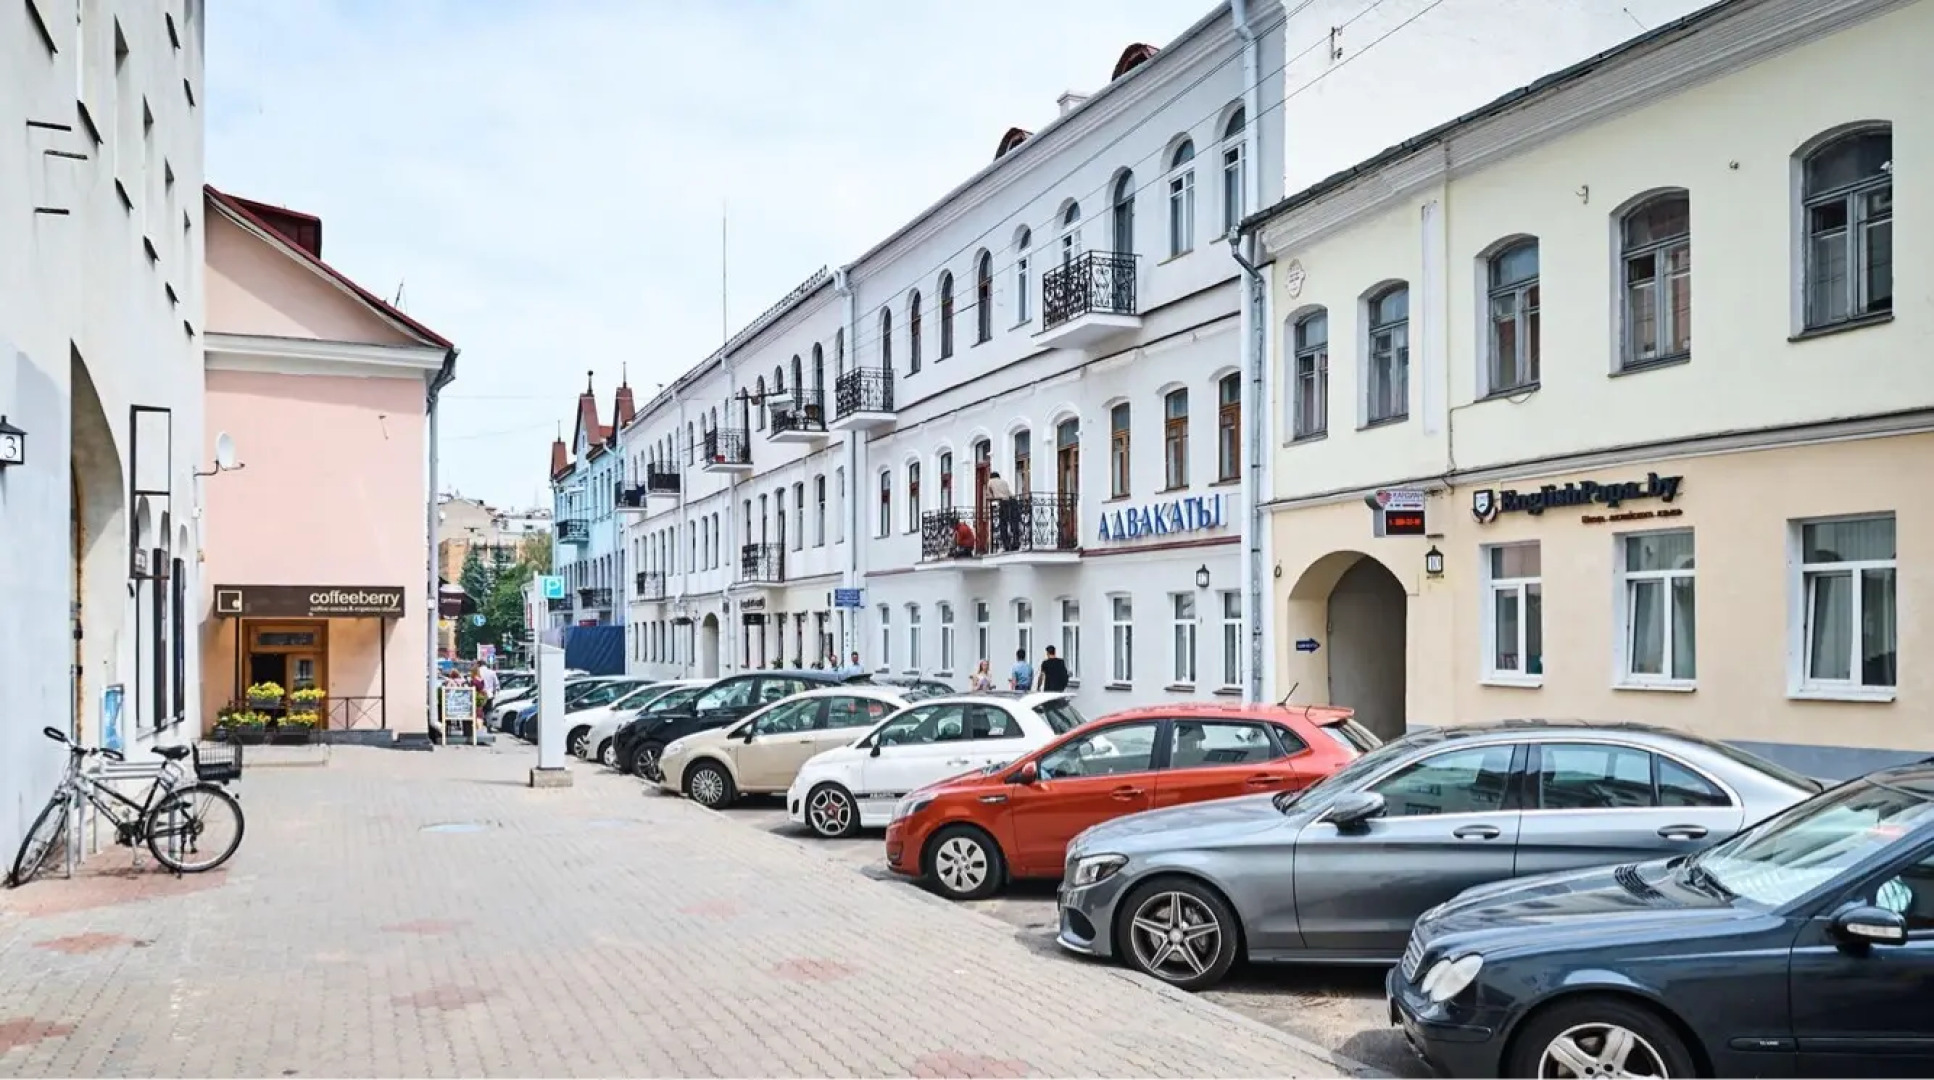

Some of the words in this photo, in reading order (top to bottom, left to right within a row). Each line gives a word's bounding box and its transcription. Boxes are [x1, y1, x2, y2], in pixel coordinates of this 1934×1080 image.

[1499, 472, 1684, 516] EnglishPapa.by
[1098, 493, 1220, 541] АДВАКАТЫ
[309, 590, 400, 607] coffeeberry
[546, 579, 560, 597] P
